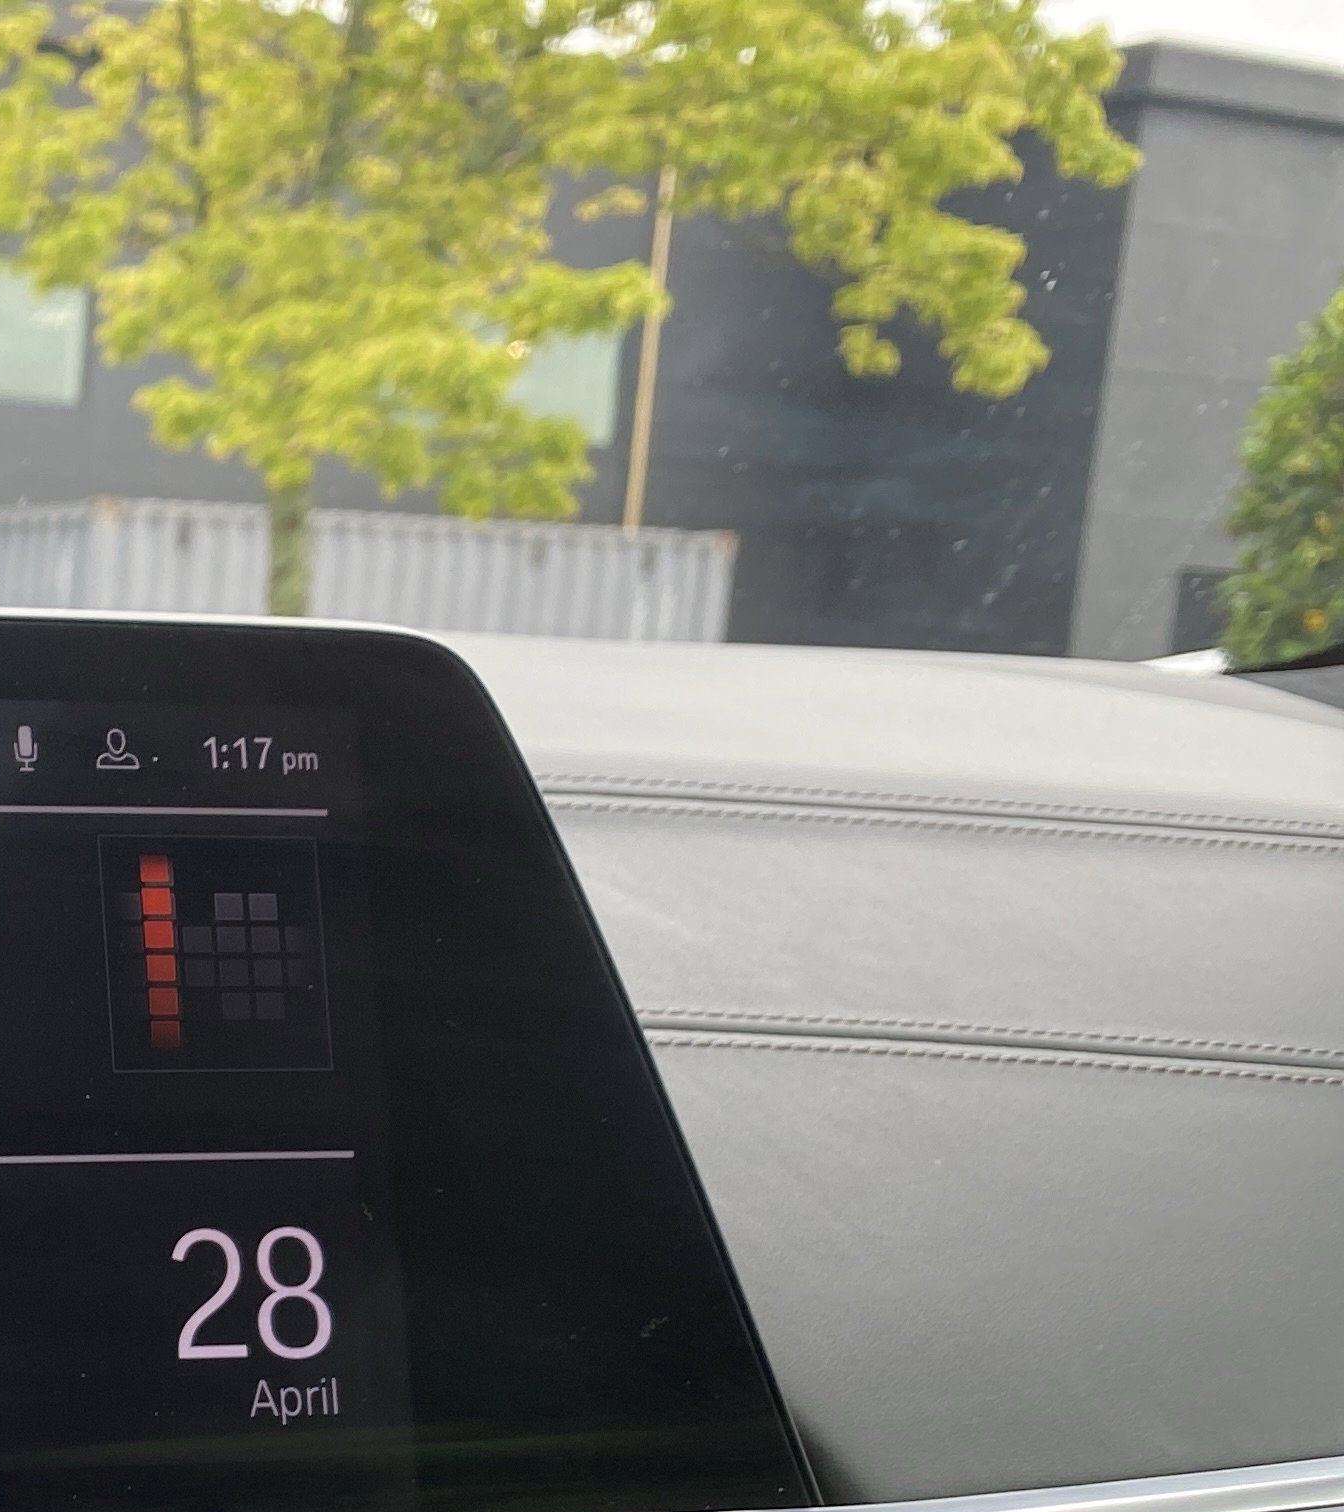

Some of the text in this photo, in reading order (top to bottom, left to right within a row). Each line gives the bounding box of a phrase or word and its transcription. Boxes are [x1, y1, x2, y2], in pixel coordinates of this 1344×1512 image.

[203, 736, 319, 775] 1:17 pm
[171, 1226, 332, 1360] 28
[250, 1377, 339, 1426] April
